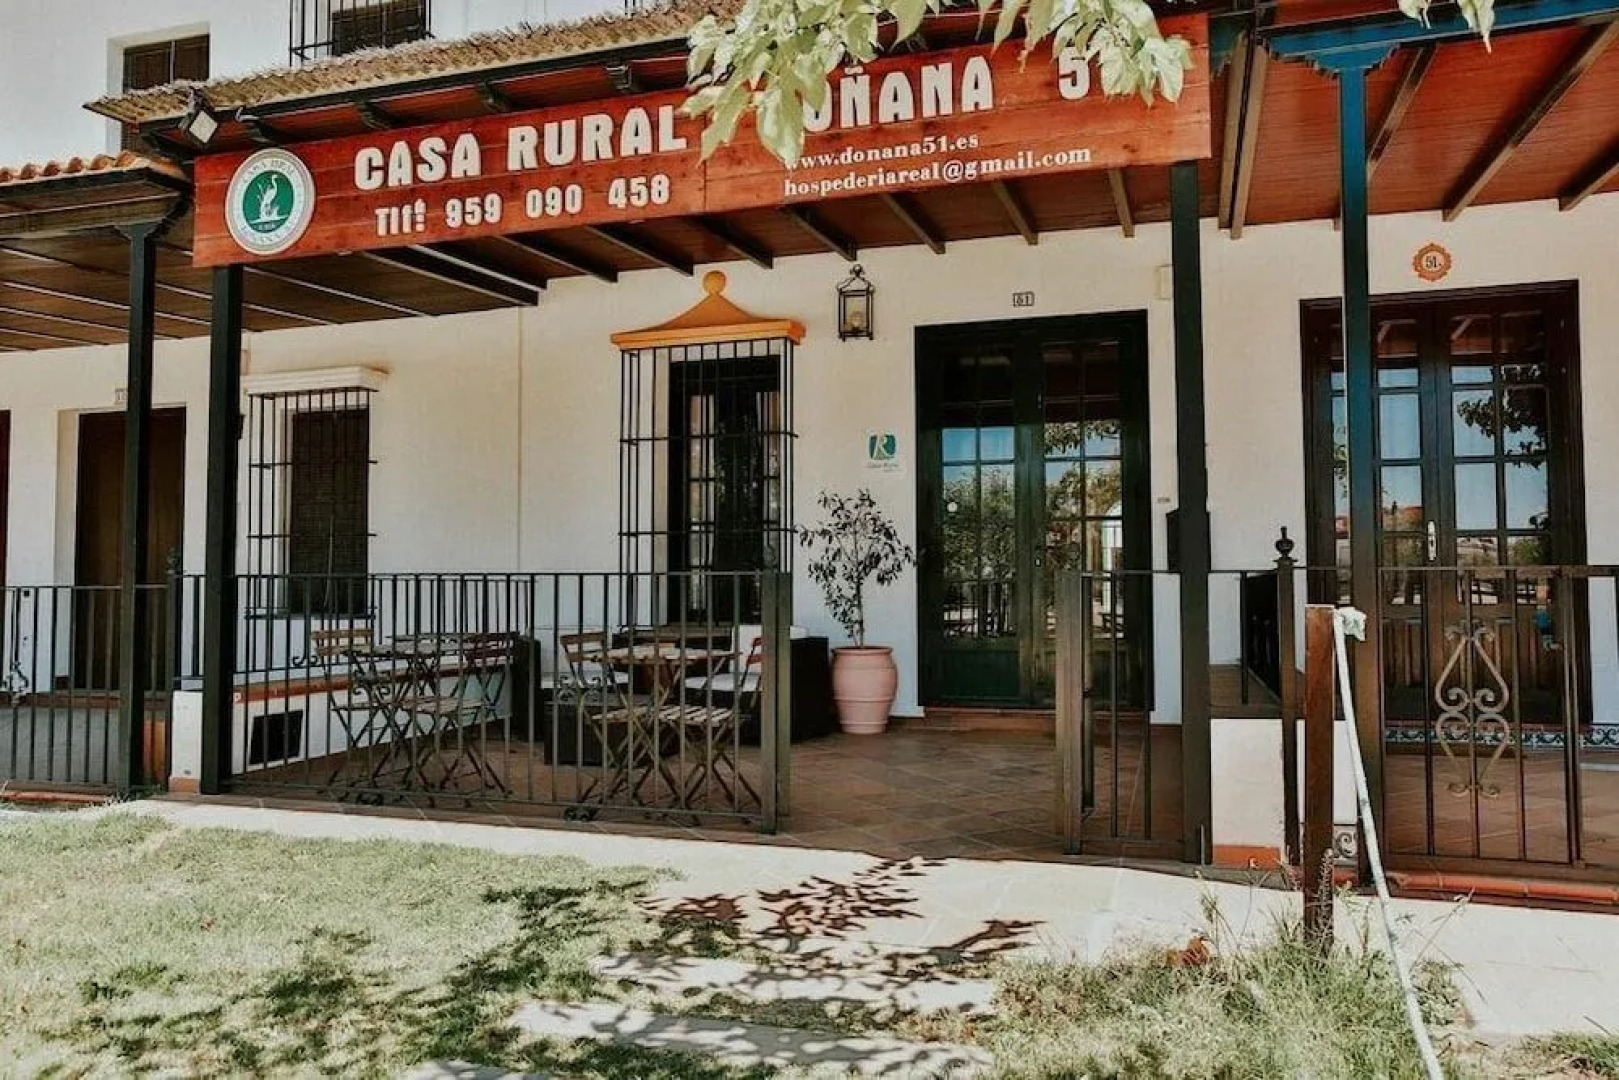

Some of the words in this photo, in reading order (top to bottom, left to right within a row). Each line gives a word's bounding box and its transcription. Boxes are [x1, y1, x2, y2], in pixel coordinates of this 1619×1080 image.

[354, 132, 482, 190] CASA
[506, 104, 688, 171] RURAL
[800, 55, 995, 132] OÑANA
[1058, 46, 1091, 99] 5
[784, 148, 1092, 197] hospederiareal@gmail.com
[445, 192, 502, 229] 959
[525, 184, 583, 218] 090
[607, 174, 671, 209] 458
[1425, 255, 1437, 269] 51
